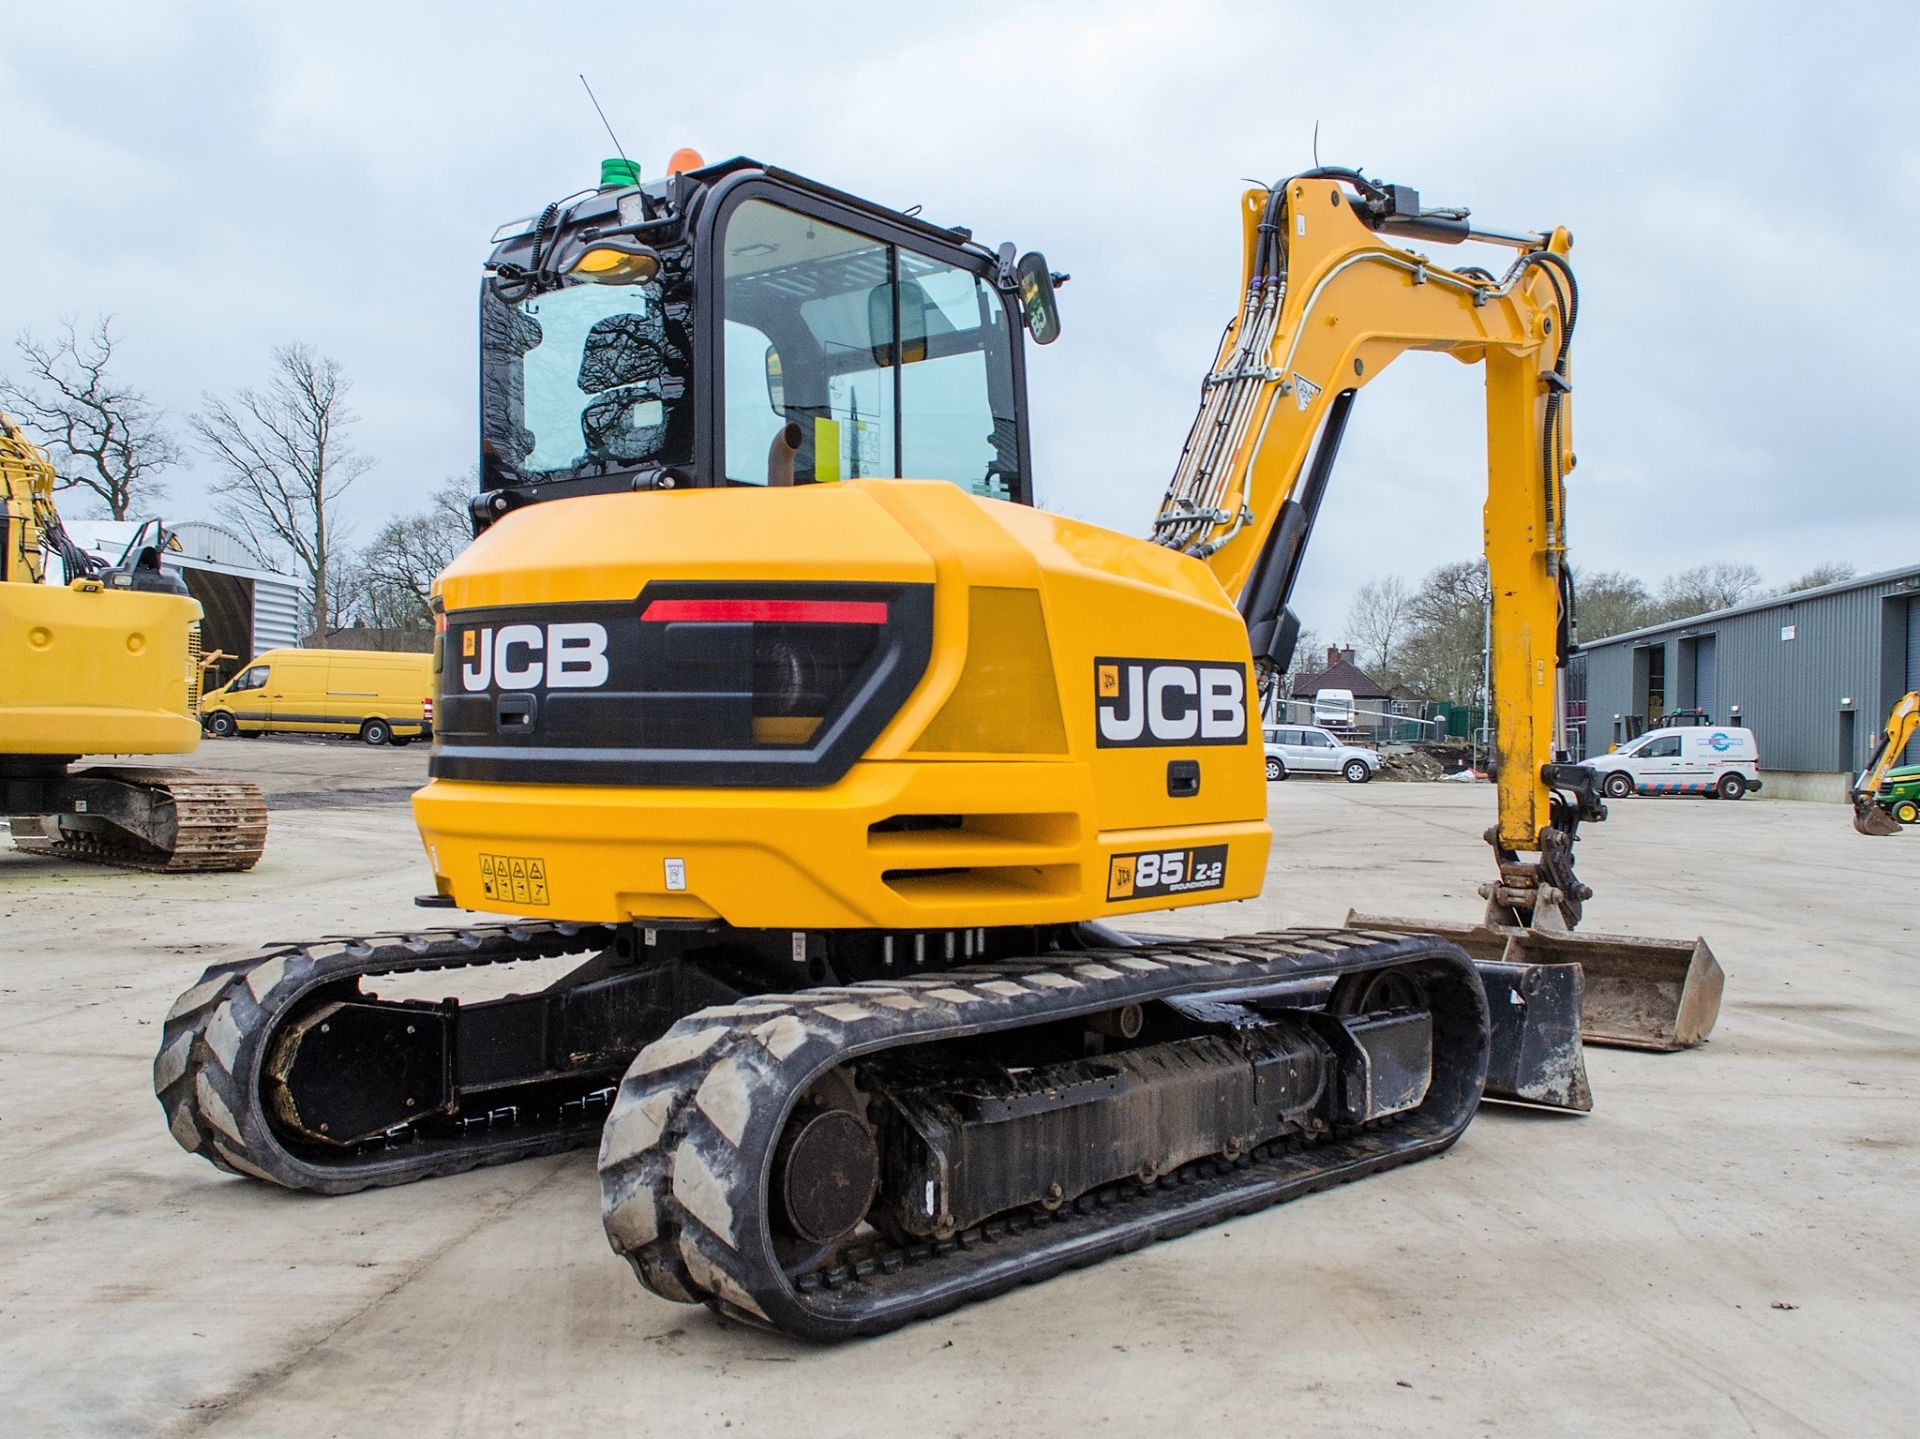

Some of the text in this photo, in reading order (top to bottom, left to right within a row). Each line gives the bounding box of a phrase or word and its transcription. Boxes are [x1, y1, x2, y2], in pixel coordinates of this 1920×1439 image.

[463, 622, 609, 692] JCB
[1099, 666, 1245, 740] JCB
[1136, 852, 1184, 887] 85
[1169, 880, 1219, 891] GROUNDWORKER
